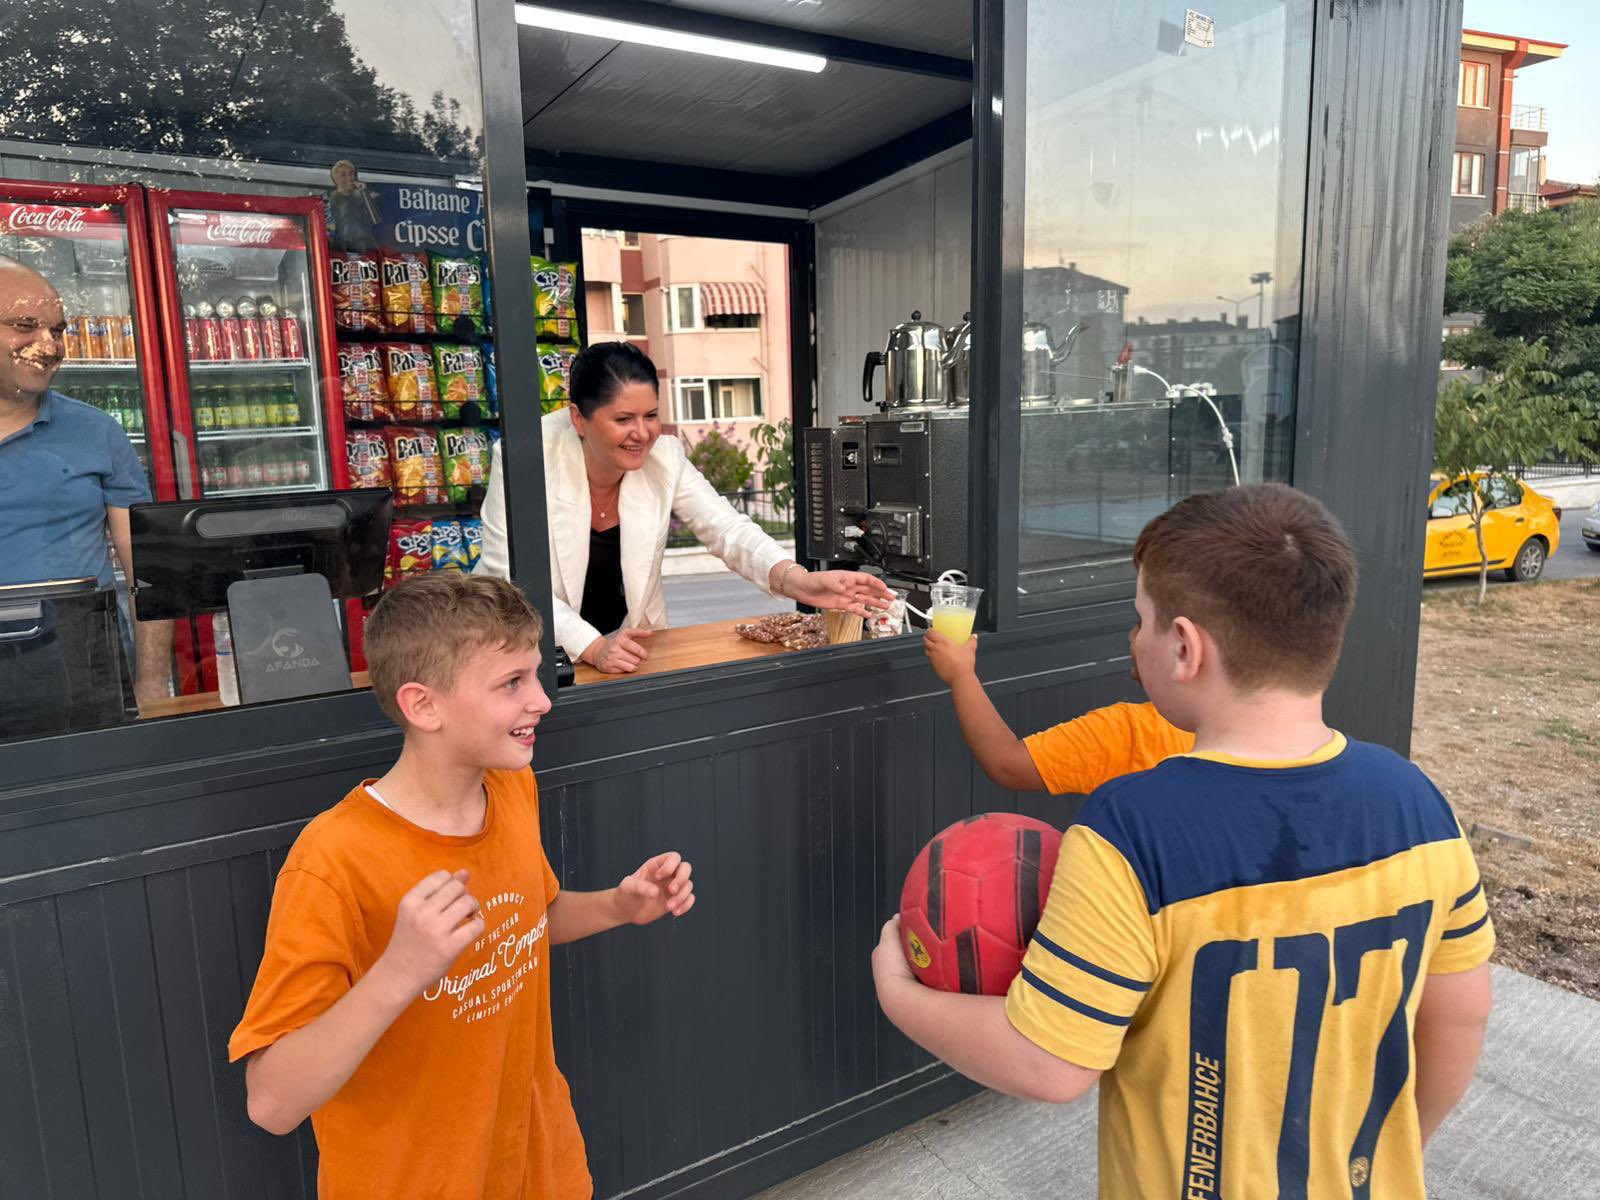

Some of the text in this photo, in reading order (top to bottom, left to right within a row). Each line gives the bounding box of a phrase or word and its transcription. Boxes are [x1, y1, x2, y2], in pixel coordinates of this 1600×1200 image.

[8, 206, 87, 233] Coca-Cola
[395, 220, 460, 247] Cipsse
[265, 657, 321, 673] AFANDA
[486, 892, 525, 912] PRODUCT
[475, 938, 486, 952] OF
[488, 928, 500, 944] THE
[452, 993, 488, 1019] CASUAL
[1188, 1052, 1222, 1200] FENERBAHÇE
